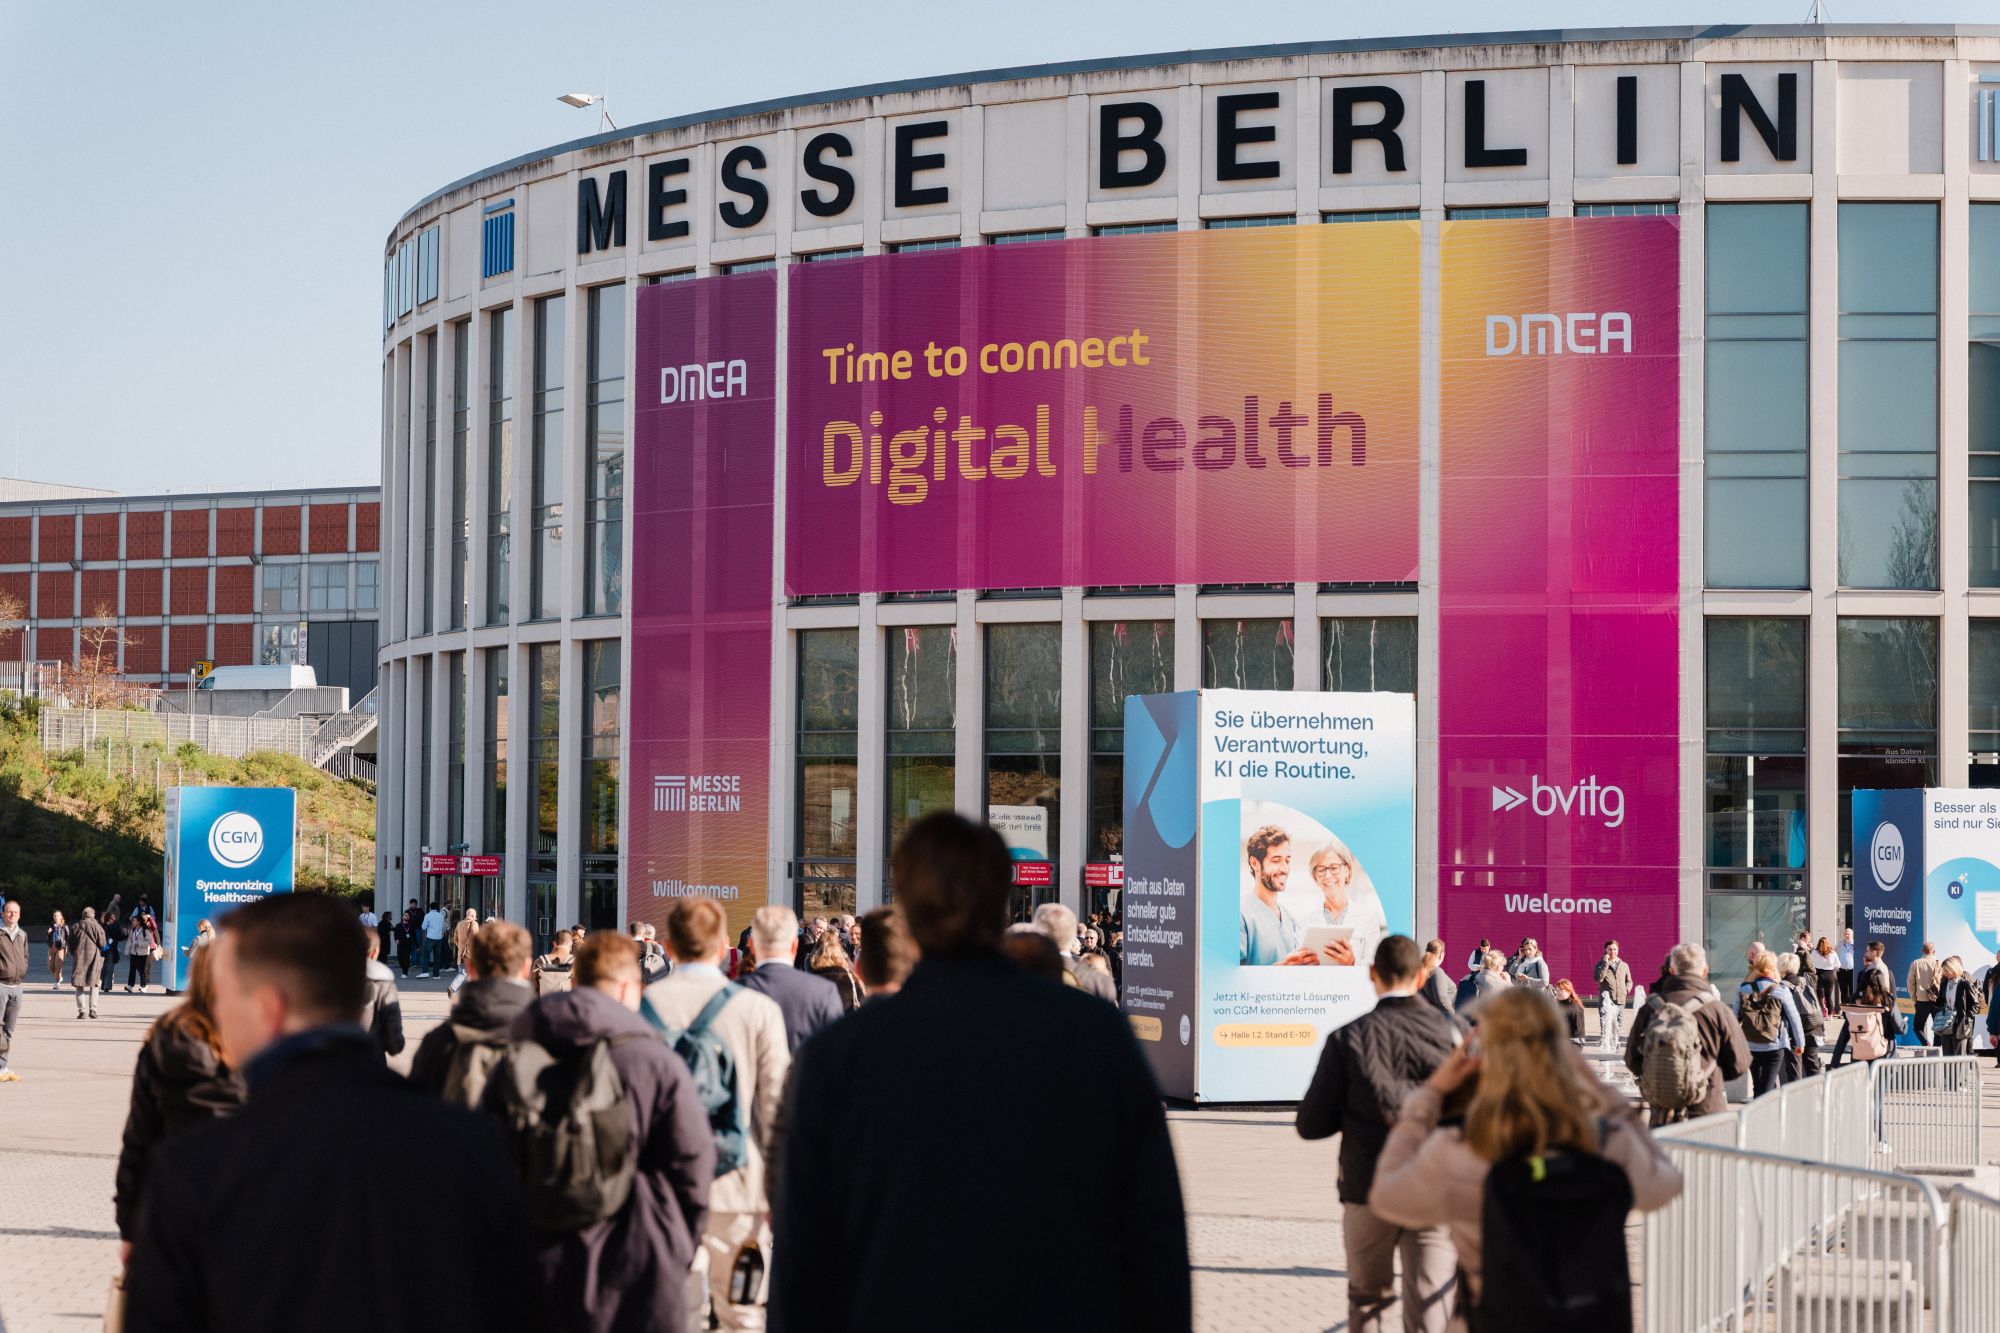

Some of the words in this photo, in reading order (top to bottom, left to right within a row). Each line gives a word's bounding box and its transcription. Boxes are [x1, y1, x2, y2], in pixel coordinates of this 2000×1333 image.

[578, 120, 949, 254] MESSE
[1100, 73, 1797, 189] BERLIN
[1486, 311, 1632, 356] DMEA
[822, 342, 913, 385] Time
[924, 341, 968, 377] to
[980, 328, 1149, 374] connect
[660, 359, 747, 404] DMEA
[822, 404, 1057, 506] Digital
[1083, 392, 1367, 474] Health
[1214, 710, 1244, 728] Sie
[1250, 711, 1374, 731] übernehmen
[1214, 735, 1368, 759] Verantwortung,
[1214, 760, 1232, 778] KI
[1239, 760, 1268, 778] die
[1275, 761, 1356, 780] Routine.
[689, 775, 740, 792] MESSE
[689, 795, 740, 812] BERLIN
[1532, 774, 1625, 828] bvitg
[1934, 801, 1976, 813] Besser
[1979, 802, 1997, 813] als
[1934, 817, 1959, 829] sind
[1963, 820, 1983, 829] nur
[221, 831, 257, 844] CGM
[1878, 846, 1901, 861] CGM
[196, 880, 273, 893] Synchronizing
[652, 879, 739, 899] Willkommen
[1127, 877, 1148, 894] Damit
[1149, 880, 1162, 896] aus
[1163, 878, 1185, 897] Daten
[1951, 887, 1960, 895] KI
[1504, 892, 1612, 913] Welcome
[1127, 901, 1158, 919] schneller
[1159, 903, 1176, 924] gute
[1864, 906, 1912, 922] Synchronizing
[1127, 924, 1183, 949] Entscheidungen
[1869, 922, 1907, 935] Healthcare
[1127, 949, 1154, 967] werden.
[1213, 992, 1237, 1001] Jetzt
[1240, 992, 1301, 1004] KI-gestützte
[1303, 992, 1350, 1004] Lösungen
[1213, 1007, 1231, 1015] von
[1233, 1005, 1258, 1015] CGM
[1260, 1006, 1326, 1015] kennenlernen
[1231, 1031, 1250, 1039] Halle
[1265, 1031, 1288, 1039] Stand
[1290, 1031, 1311, 1039] E-101
